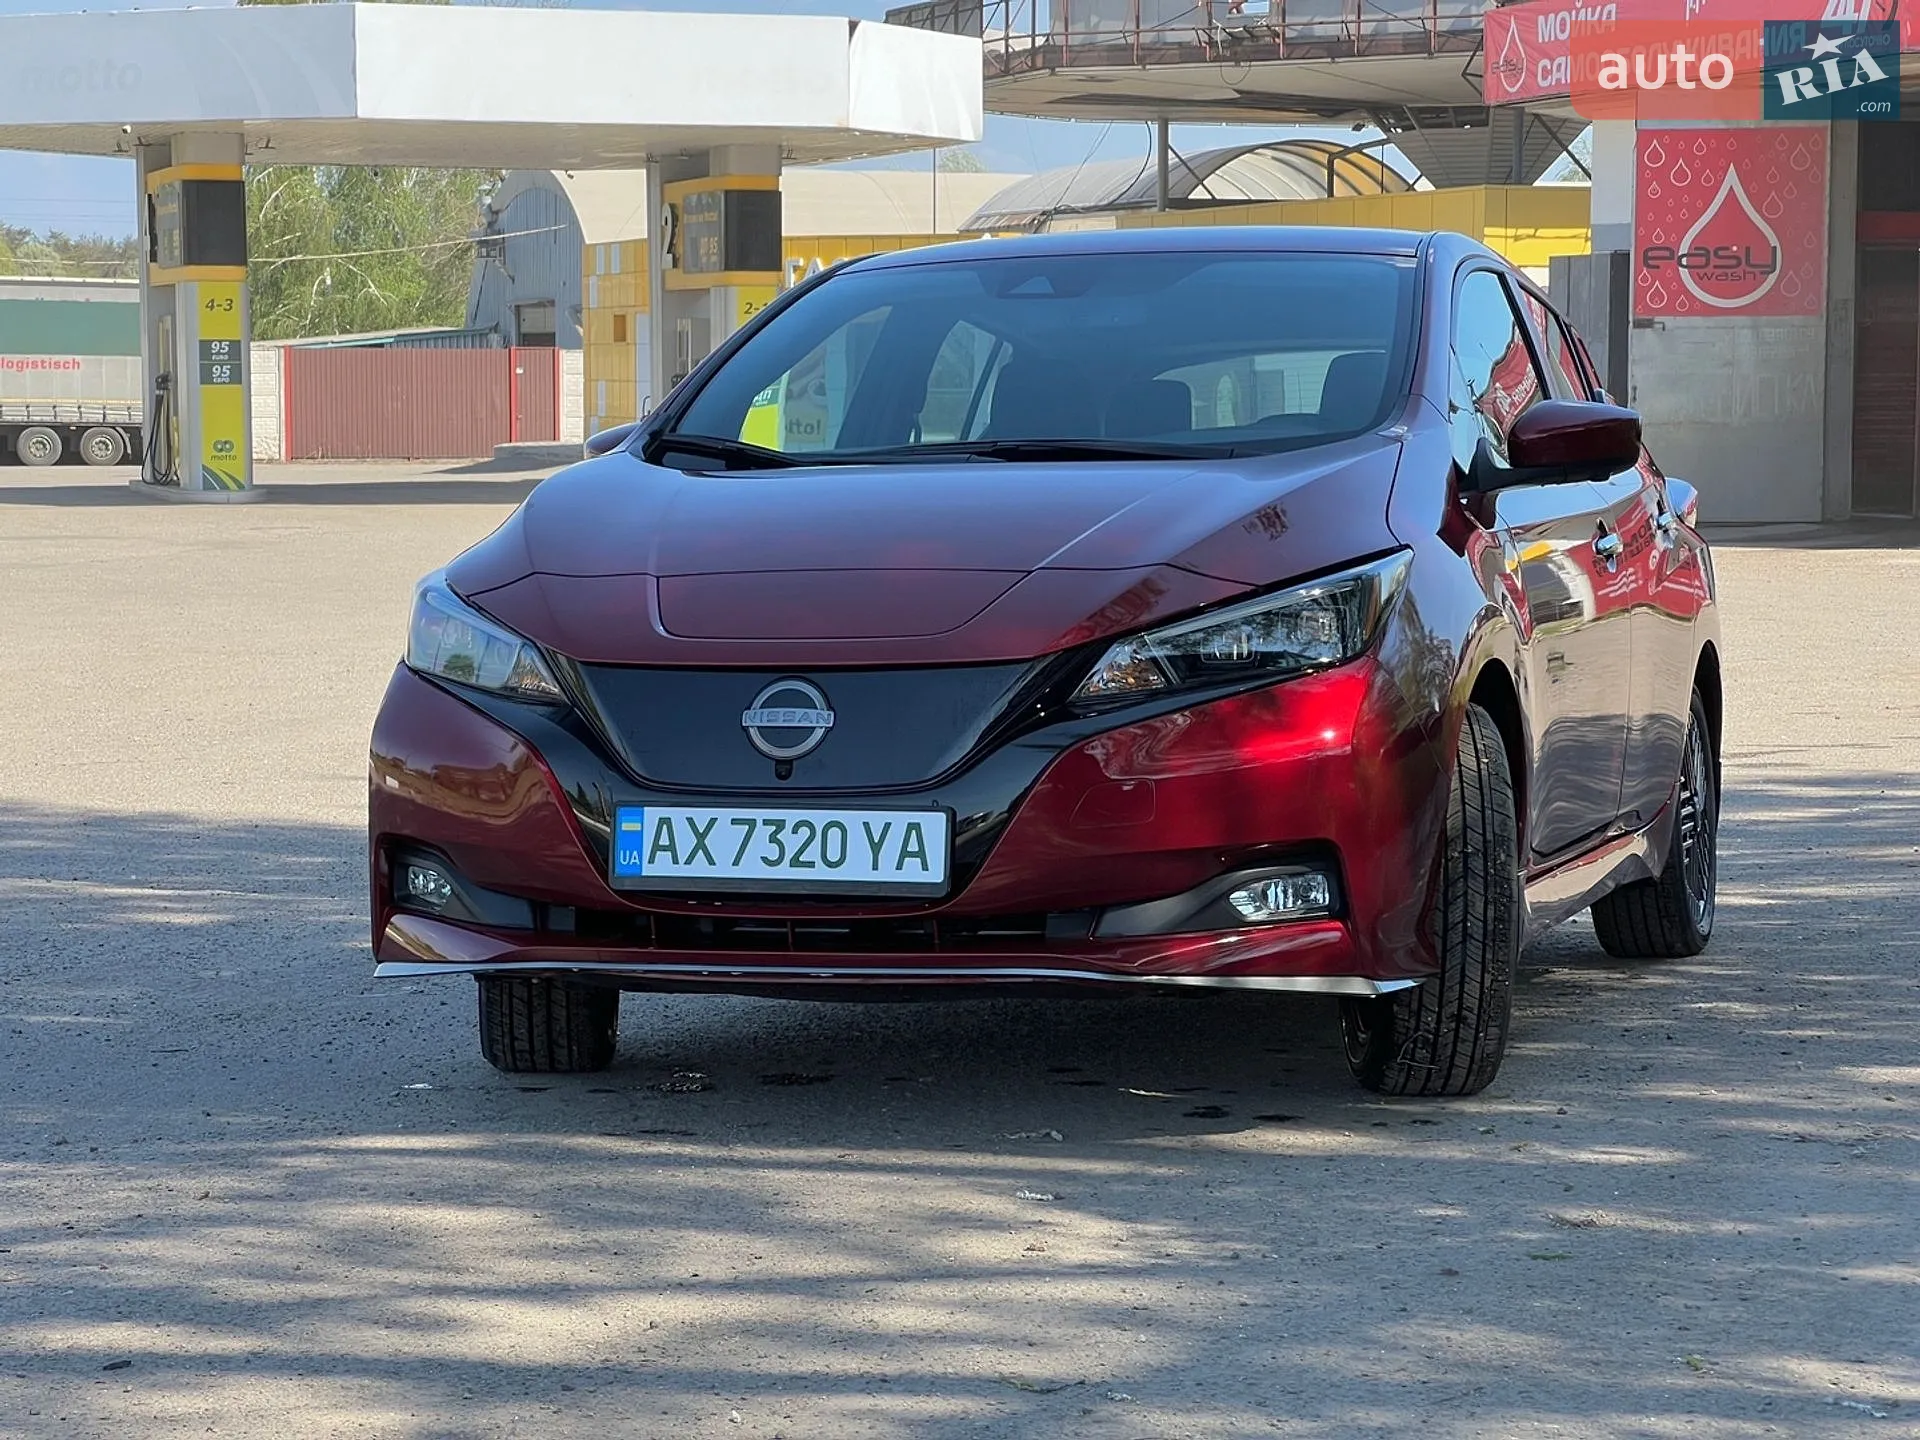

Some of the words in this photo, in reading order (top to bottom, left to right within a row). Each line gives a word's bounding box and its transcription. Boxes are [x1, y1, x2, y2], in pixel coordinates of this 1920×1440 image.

[1643, 246, 1777, 274] easy
[1696, 270, 1756, 281] wash
[205, 298, 233, 312] 4-3
[744, 302, 768, 315] 2-
[211, 341, 230, 353] 95
[212, 365, 231, 377] 95
[743, 711, 832, 724] NISSAN
[647, 817, 719, 866] AX
[730, 818, 848, 869] 7320
[862, 821, 929, 872] YA
[620, 850, 640, 866] UA
